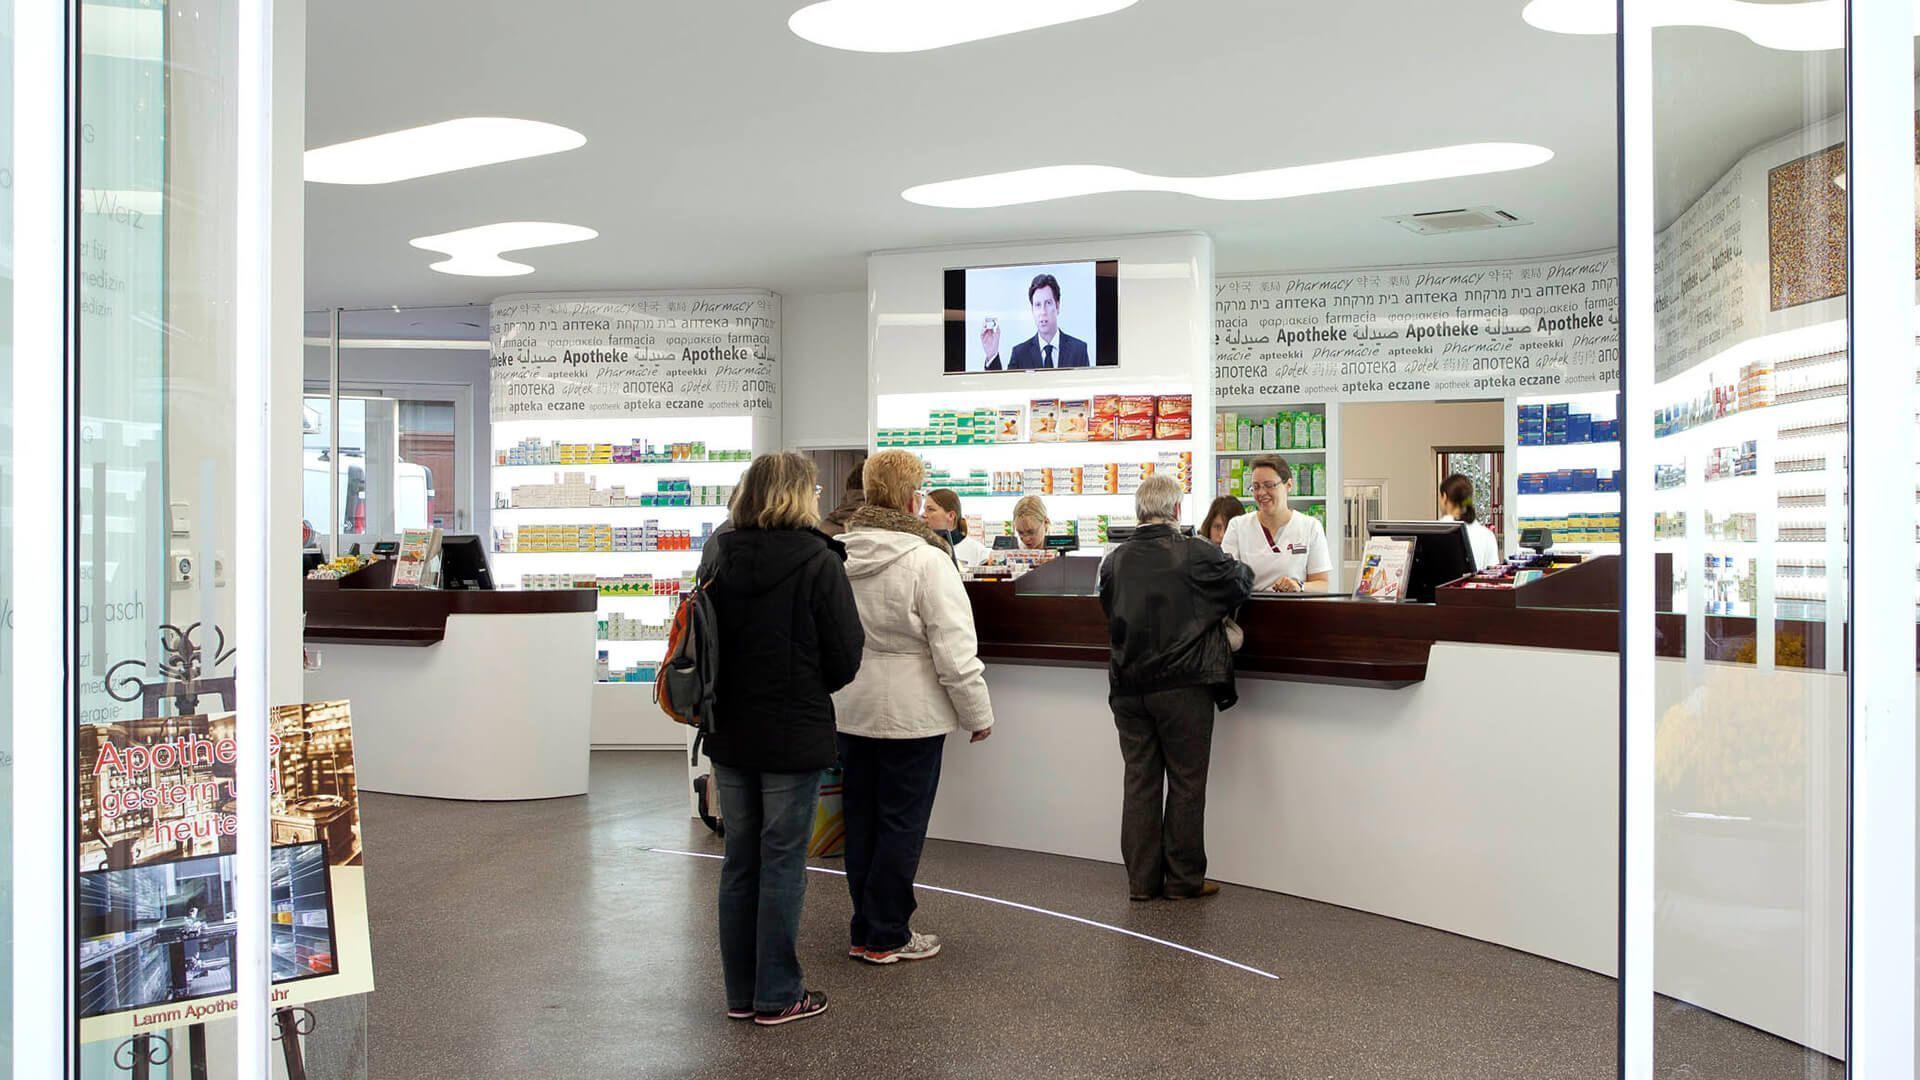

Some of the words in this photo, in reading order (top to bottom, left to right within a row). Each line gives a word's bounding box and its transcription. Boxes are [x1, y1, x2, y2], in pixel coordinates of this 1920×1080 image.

[1216, 300, 1246, 314] מרקח
[1275, 297, 1326, 309] аптека
[1405, 291, 1457, 305] аптека
[1536, 282, 1585, 297] аптека
[562, 319, 610, 331] аптека
[681, 316, 729, 329] аптека
[1216, 316, 1249, 328] macia
[1326, 311, 1376, 324] farmacia
[1456, 305, 1508, 319] farmacia
[608, 334, 655, 346] farmacia
[1276, 326, 1347, 346] Apotheke
[1405, 320, 1478, 342] Apotheke
[1537, 311, 1604, 336] Apotheke
[562, 348, 628, 367] Apotheke
[682, 345, 748, 364] Apotheke
[1216, 351, 1252, 361] macie
[1259, 350, 1303, 361] apteekki
[1388, 345, 1433, 357] apteekki
[1519, 340, 1564, 351] apteekki
[1341, 361, 1396, 375] апотека
[1473, 355, 1529, 370] апотека
[508, 382, 555, 396] апотека
[623, 380, 674, 393] апотека
[1216, 383, 1255, 398] apteka
[1259, 384, 1300, 394] eczane
[1342, 379, 1383, 395] apteka
[1388, 380, 1431, 391] eczane
[1474, 374, 1516, 390] apteka
[1519, 374, 1561, 386] eczane
[509, 400, 543, 412] apteka
[547, 401, 585, 411] eczane
[624, 398, 661, 412] apteka
[665, 399, 704, 409] eczane
[93, 732, 281, 779] Apothee
[101, 780, 220, 818] gestern
[228, 768, 280, 799] ud
[153, 812, 238, 845] heute
[132, 1007, 182, 1028] Lamm
[184, 998, 238, 1020] Apothe
